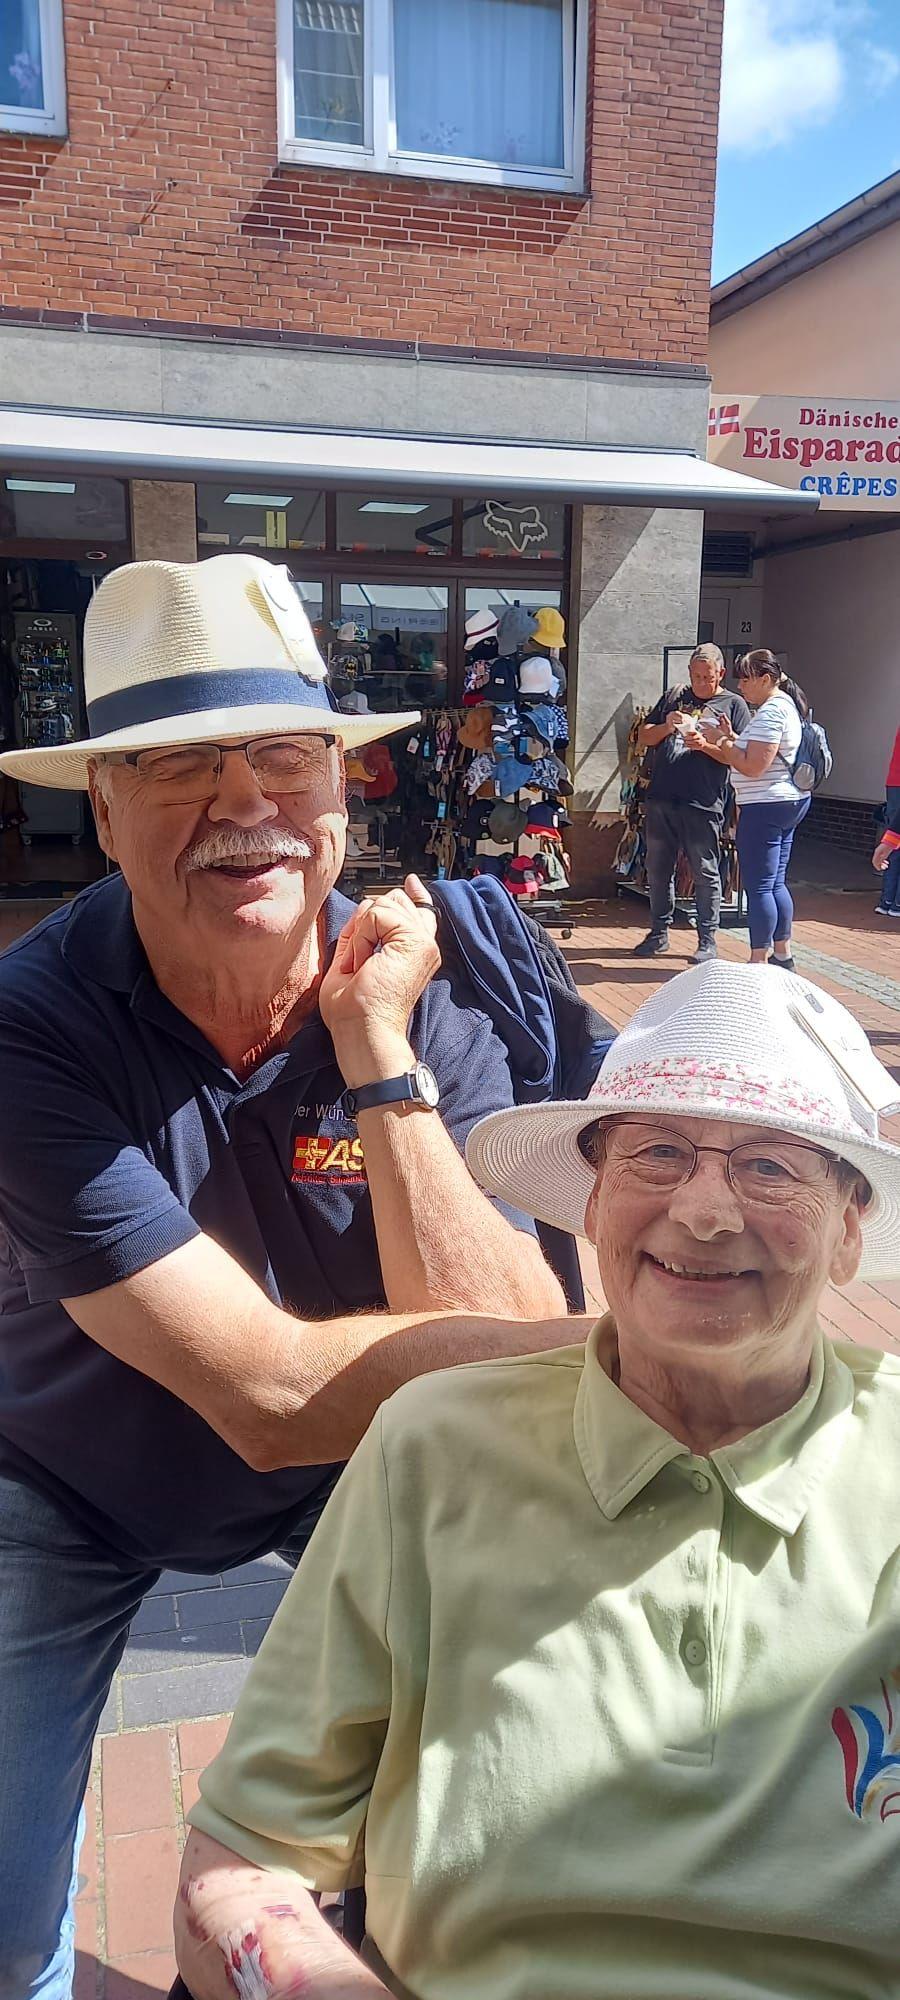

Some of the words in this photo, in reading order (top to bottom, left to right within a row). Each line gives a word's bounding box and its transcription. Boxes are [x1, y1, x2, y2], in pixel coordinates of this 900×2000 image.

[799, 408, 898, 429] Dänische
[800, 471, 897, 497] CRÊPES
[741, 621, 752, 633] 23
[315, 1103, 357, 1122] Wün
